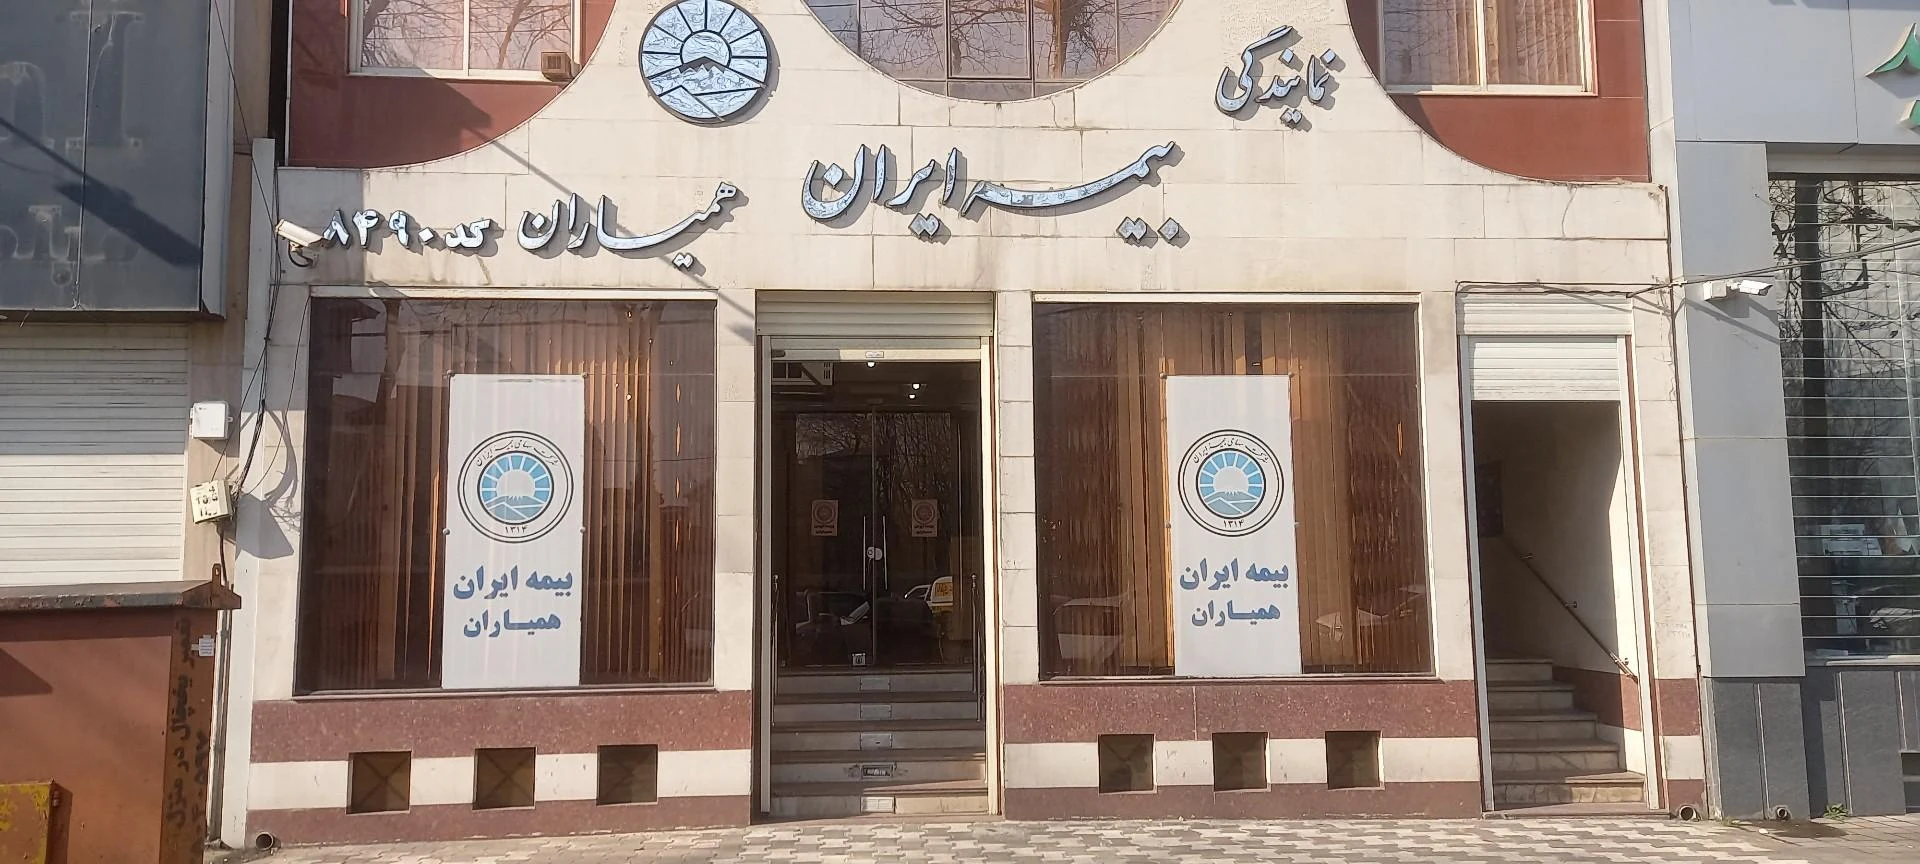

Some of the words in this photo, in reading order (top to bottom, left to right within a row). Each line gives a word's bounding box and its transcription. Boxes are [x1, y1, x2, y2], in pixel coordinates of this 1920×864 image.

[1214, 25, 1337, 127] نمایندگی
[801, 144, 962, 239] ایران
[961, 140, 1182, 241] بیمه
[323, 209, 436, 250] ۸۴۹۰
[444, 217, 494, 250] کد
[517, 181, 739, 270] همیاران
[504, 525, 528, 535] ۱۳۱۴
[1223, 519, 1245, 528] ۱۳۱۴
[452, 564, 518, 600] ایران
[525, 568, 573, 597] بیمه
[1179, 557, 1239, 590] ایران
[1245, 561, 1289, 589] بیمه
[463, 608, 561, 638] همیاران
[1191, 600, 1281, 627] همیاران
